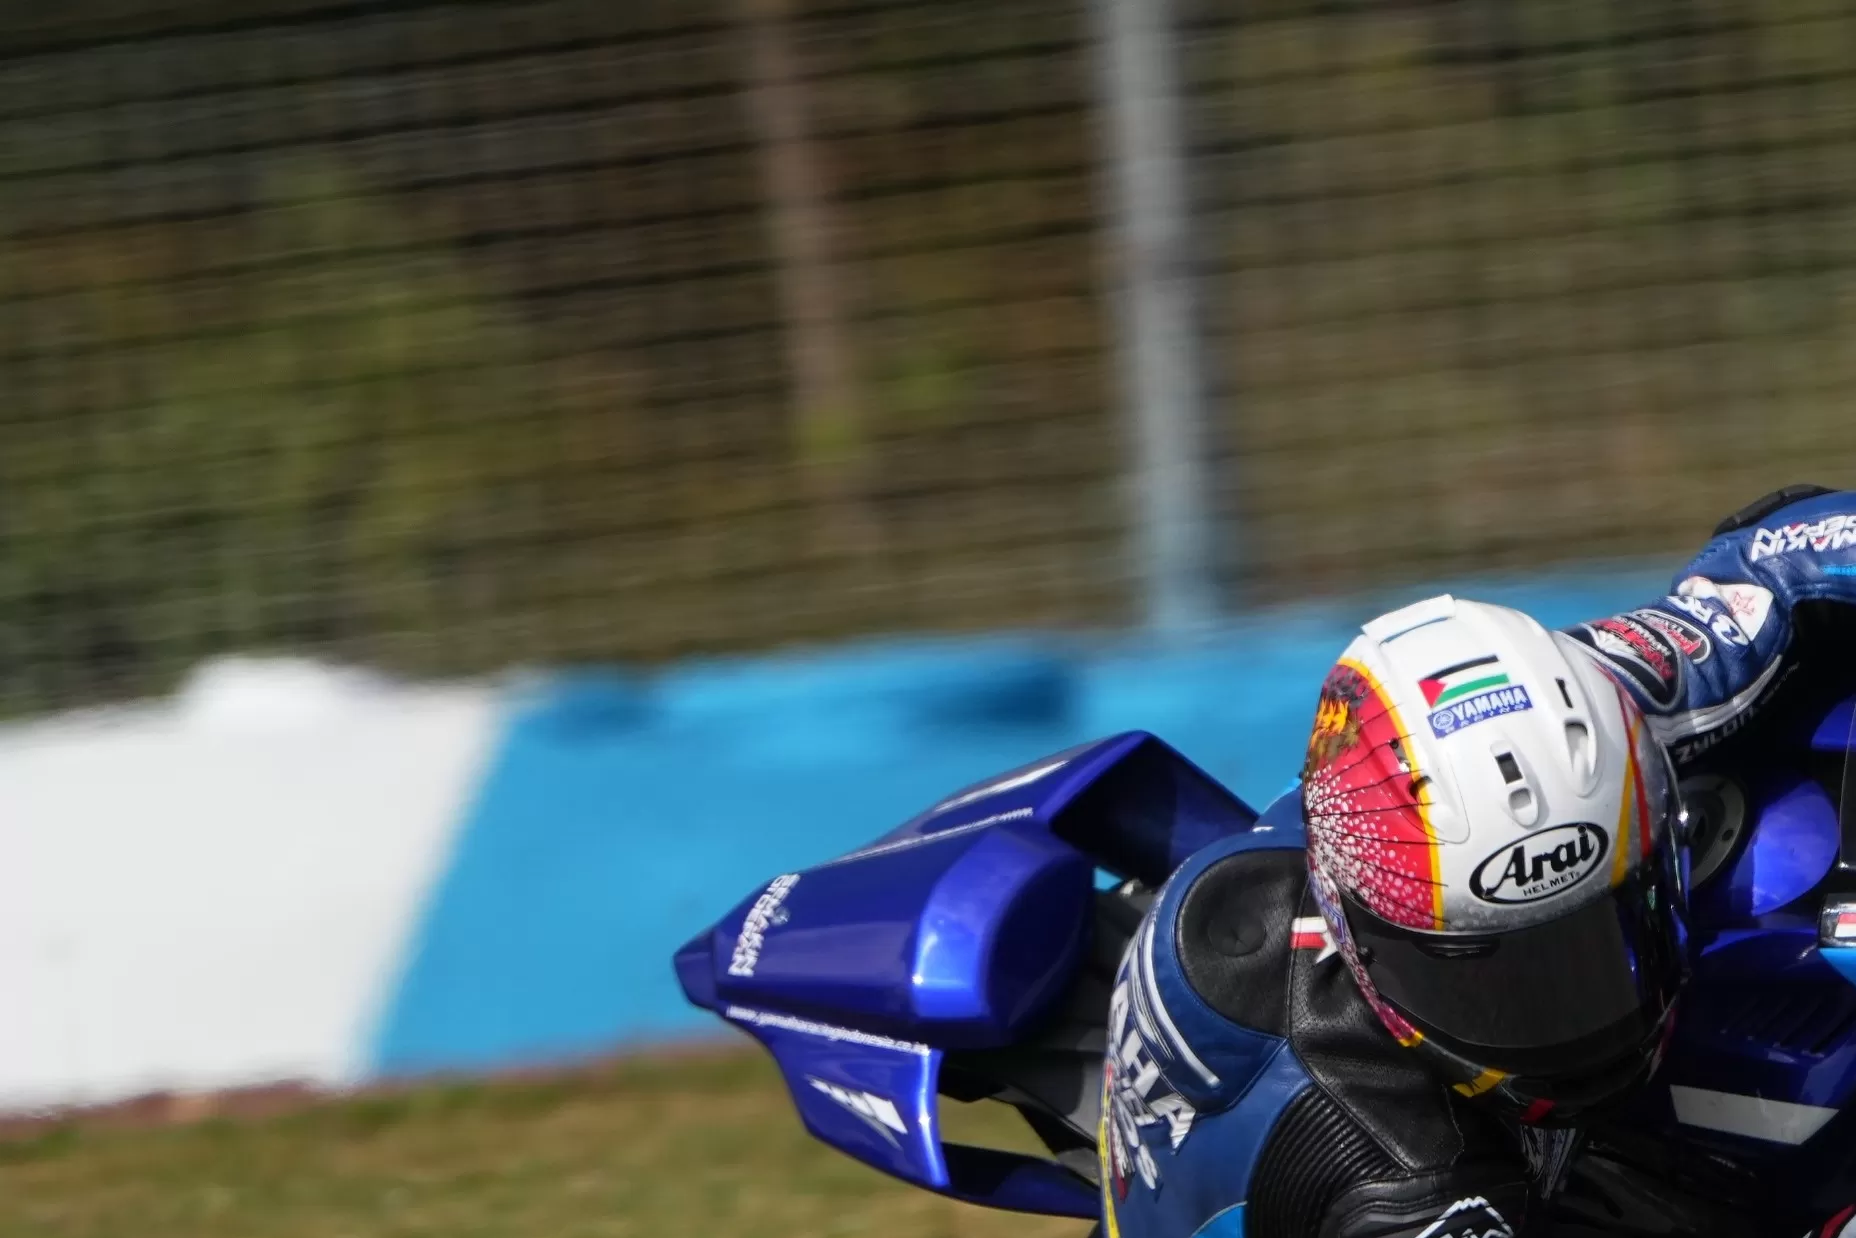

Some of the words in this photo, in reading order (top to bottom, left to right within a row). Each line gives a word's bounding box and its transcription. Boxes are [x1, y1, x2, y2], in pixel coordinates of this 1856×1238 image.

[1452, 689, 1527, 721] YAMAHA
[1485, 824, 1595, 899] Arai
[1523, 869, 1577, 897] HELMET
[1109, 979, 1196, 1150] AHA
